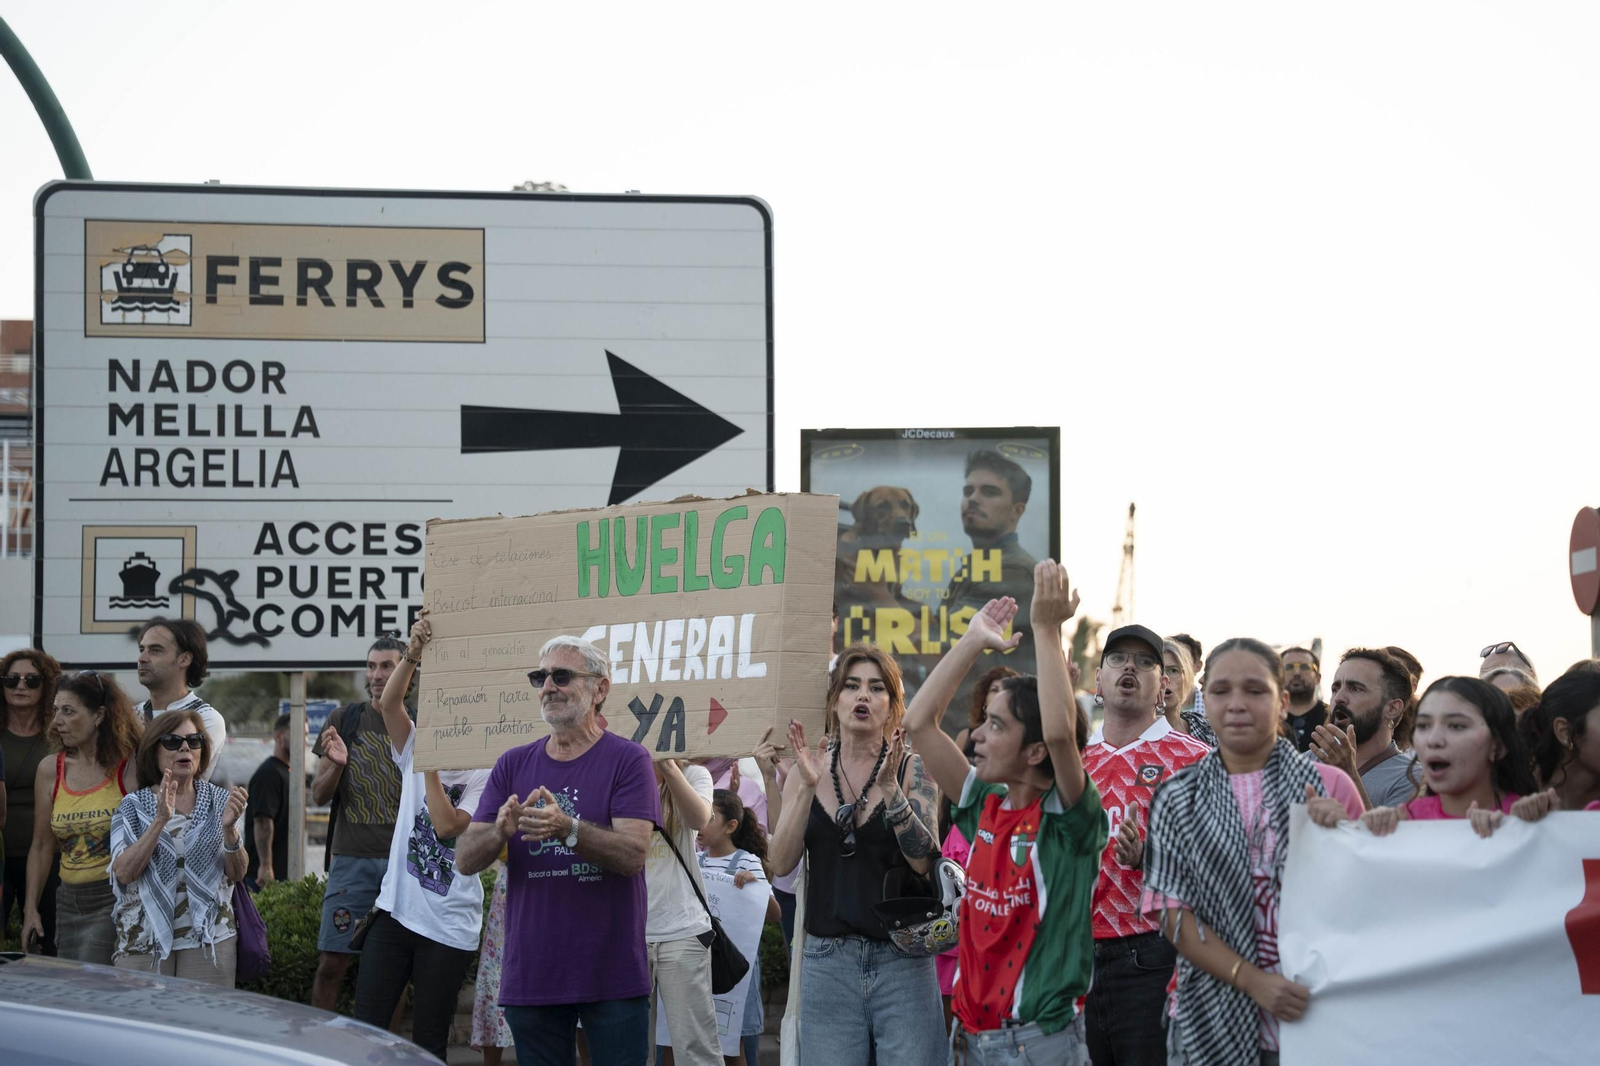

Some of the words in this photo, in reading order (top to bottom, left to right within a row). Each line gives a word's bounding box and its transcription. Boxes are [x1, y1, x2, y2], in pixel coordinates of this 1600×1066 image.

[205, 254, 474, 310] FERRYS
[108, 358, 287, 394] NADOR
[108, 402, 321, 438] MELILLA
[901, 428, 955, 439] JCDecaux
[99, 447, 300, 488] ARGELIA
[470, 544, 483, 565] de
[576, 504, 787, 599] HUELGA
[854, 548, 1003, 583] MATCH
[256, 565, 426, 600] PUERT
[434, 585, 477, 615] Boicot
[489, 585, 559, 608] internacional
[907, 587, 931, 600] SOY
[935, 588, 951, 600] TU
[844, 605, 1014, 655] CRUS
[460, 637, 470, 659] al
[481, 639, 525, 669] genocidio
[436, 686, 488, 714] Reparación
[498, 690, 531, 713] para
[433, 716, 473, 750] pueblo
[484, 714, 535, 750] palestino
[628, 693, 686, 753] YA
[528, 871, 546, 879] Boicot
[552, 869, 569, 877] Israel
